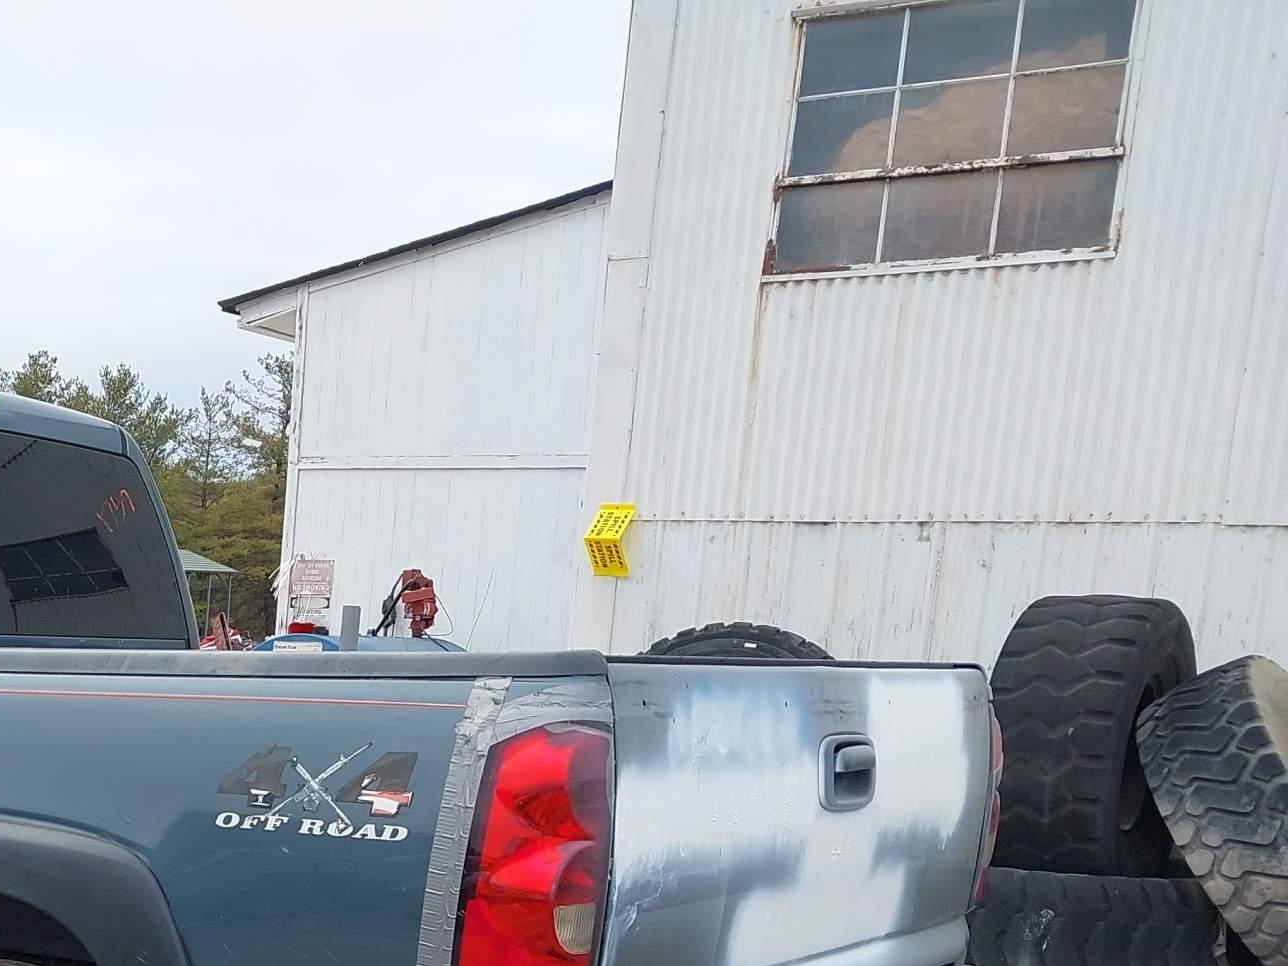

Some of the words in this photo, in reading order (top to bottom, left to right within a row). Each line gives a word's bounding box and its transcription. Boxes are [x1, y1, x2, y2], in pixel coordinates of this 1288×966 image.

[595, 512, 614, 536] STATION
[607, 516, 621, 532] SPILL
[595, 541, 608, 568] STATION
[605, 546, 616, 563] SPILL
[215, 811, 289, 831] OFF
[297, 818, 409, 842] ROAD
